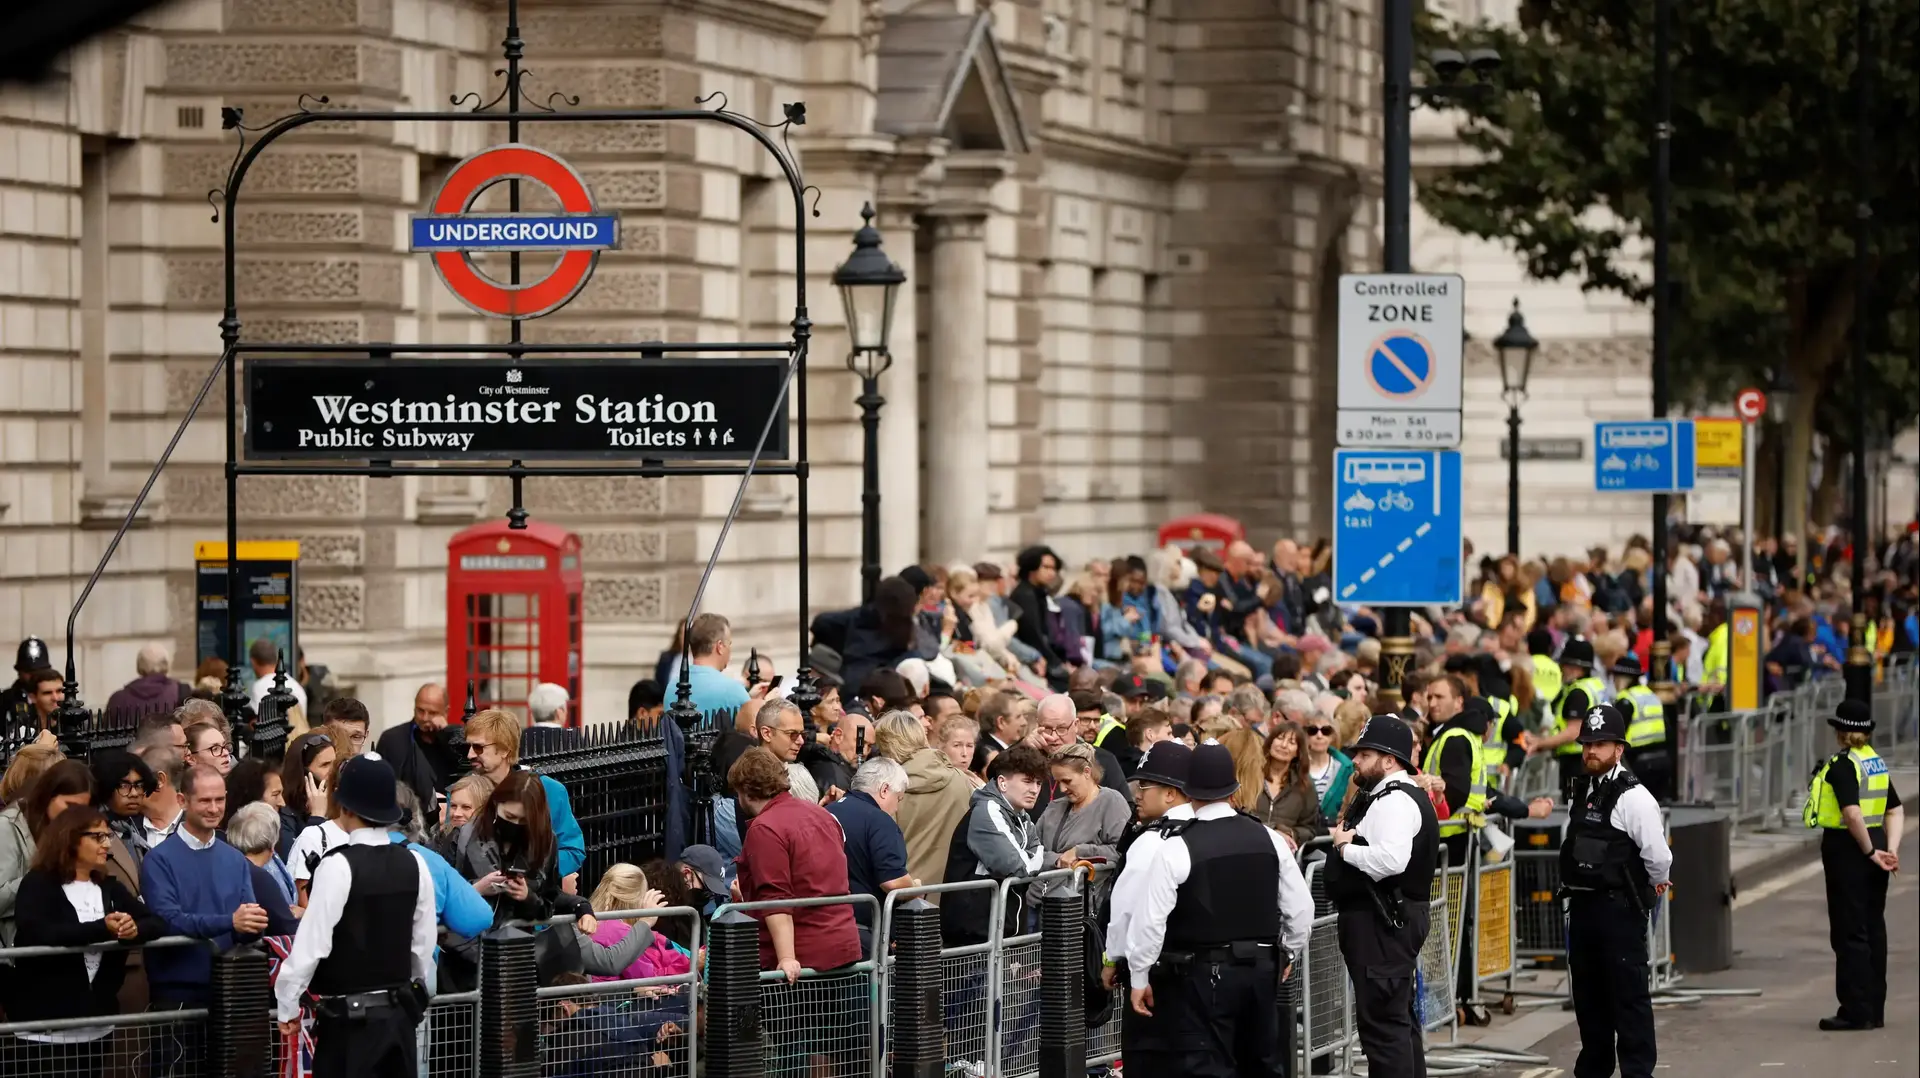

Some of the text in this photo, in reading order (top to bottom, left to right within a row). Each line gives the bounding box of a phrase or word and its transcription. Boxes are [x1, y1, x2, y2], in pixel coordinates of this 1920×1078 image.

[429, 222, 598, 241] UNDERGROUND
[1354, 280, 1448, 296] Controlled
[1368, 304, 1434, 322] ZONE
[478, 385, 550, 397] City of Westminster
[312, 393, 718, 425] Westminster Station
[1738, 391, 1760, 418] C
[1371, 416, 1427, 426] Mon Sat
[298, 427, 474, 451] Public Subway
[606, 427, 687, 447] Toilets
[1344, 514, 1373, 528] taxi
[1864, 758, 1887, 773] POLIC
